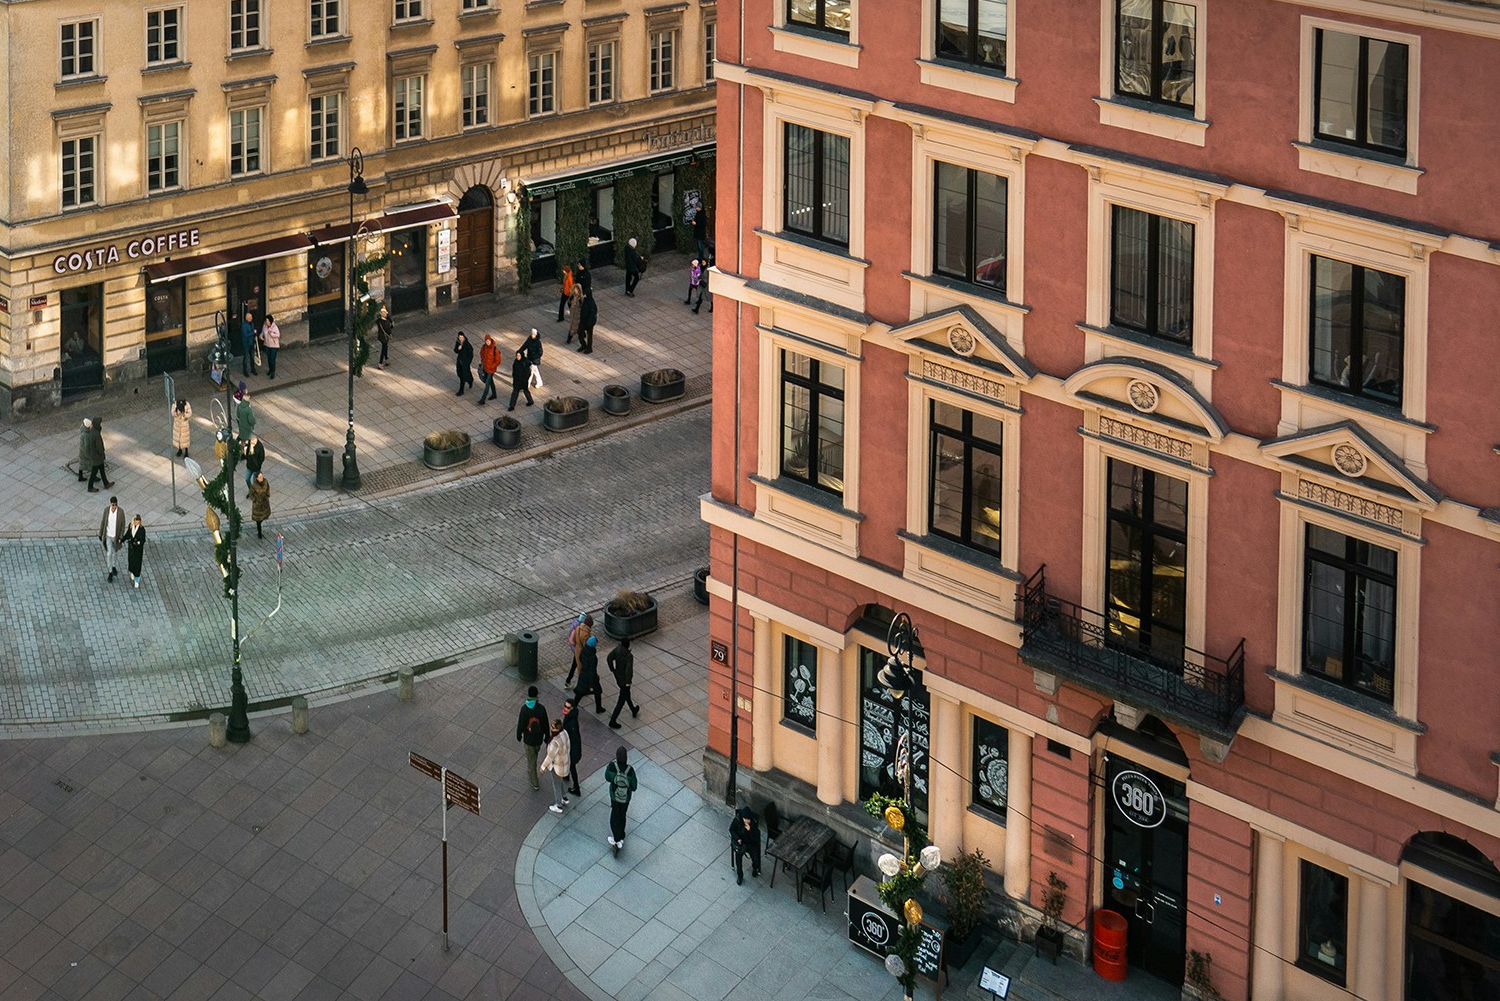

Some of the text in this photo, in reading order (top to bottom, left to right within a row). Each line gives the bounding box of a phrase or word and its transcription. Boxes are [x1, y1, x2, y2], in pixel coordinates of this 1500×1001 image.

[54, 229, 200, 274] COSTA COFFEE
[713, 648, 724, 662] 79
[864, 699, 894, 724] PIZZA
[897, 724, 929, 751] PTA
